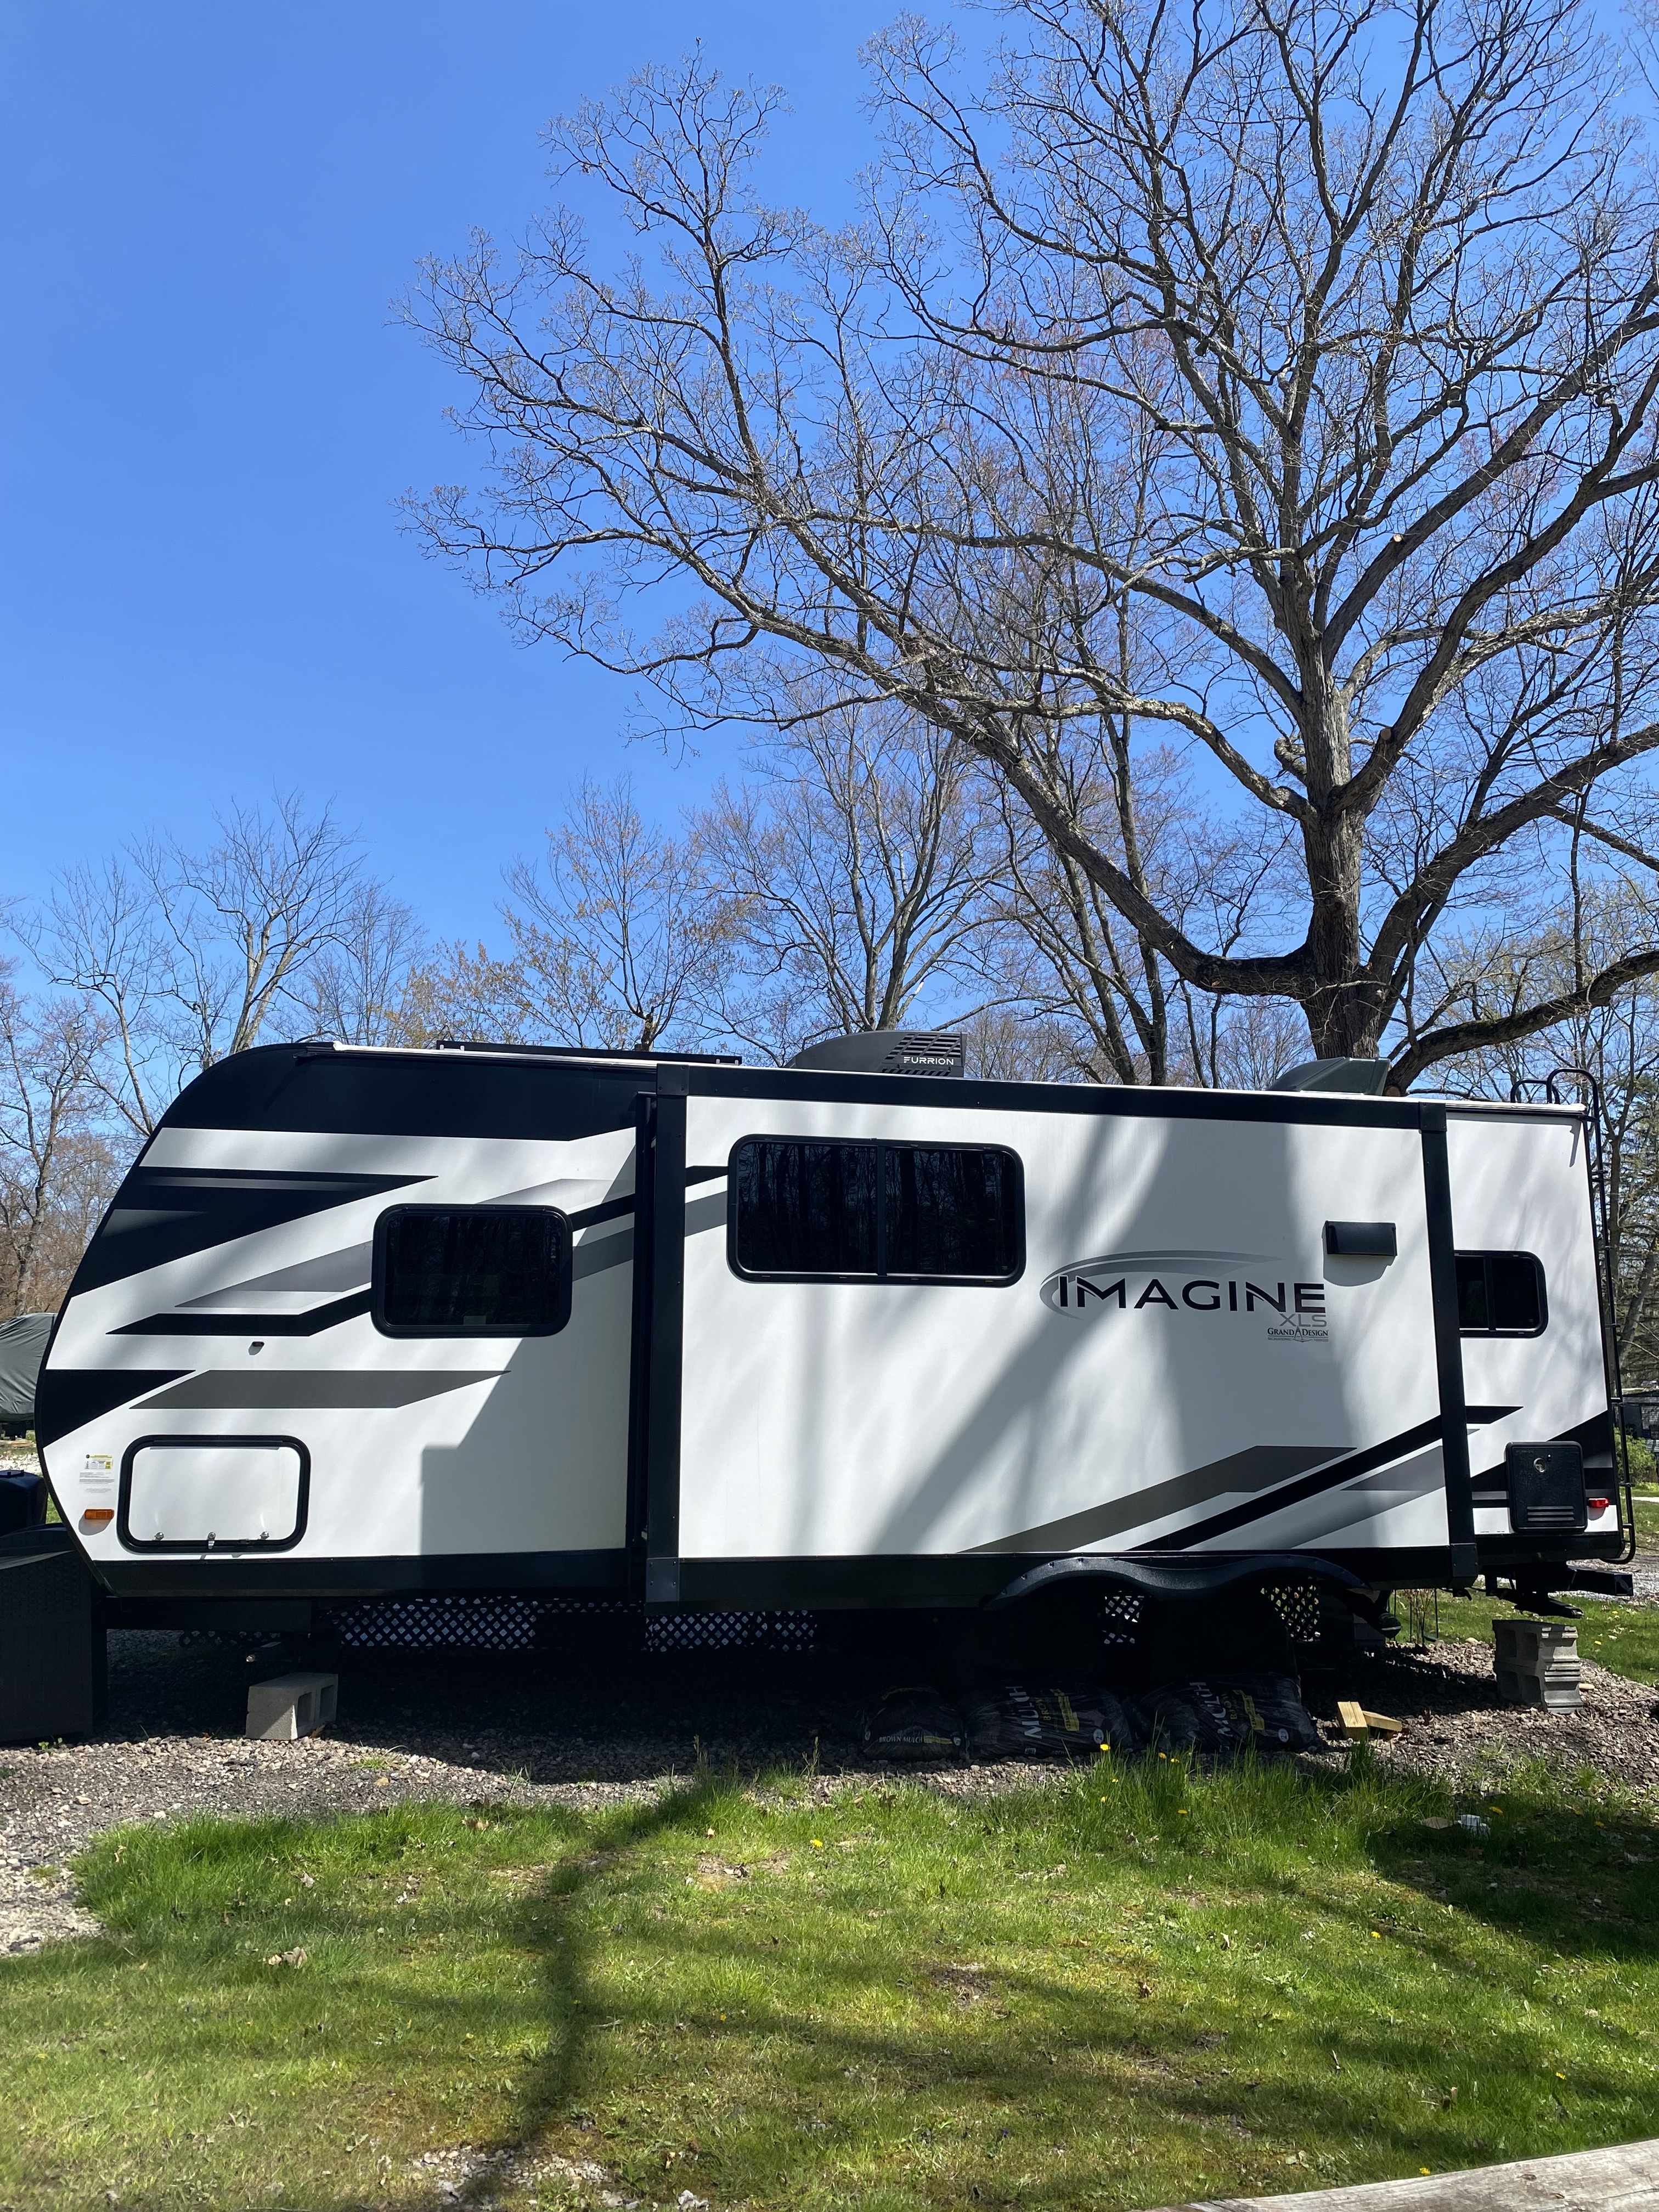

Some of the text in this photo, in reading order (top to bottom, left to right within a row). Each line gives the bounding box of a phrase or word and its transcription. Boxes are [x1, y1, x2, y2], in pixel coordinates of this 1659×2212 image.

[904, 1056, 954, 1065] FURRION
[1059, 1275, 1326, 1313] IMAGINE
[1279, 1313, 1327, 1328] XLS
[1267, 1327, 1328, 1336] GRAND DESIGN
